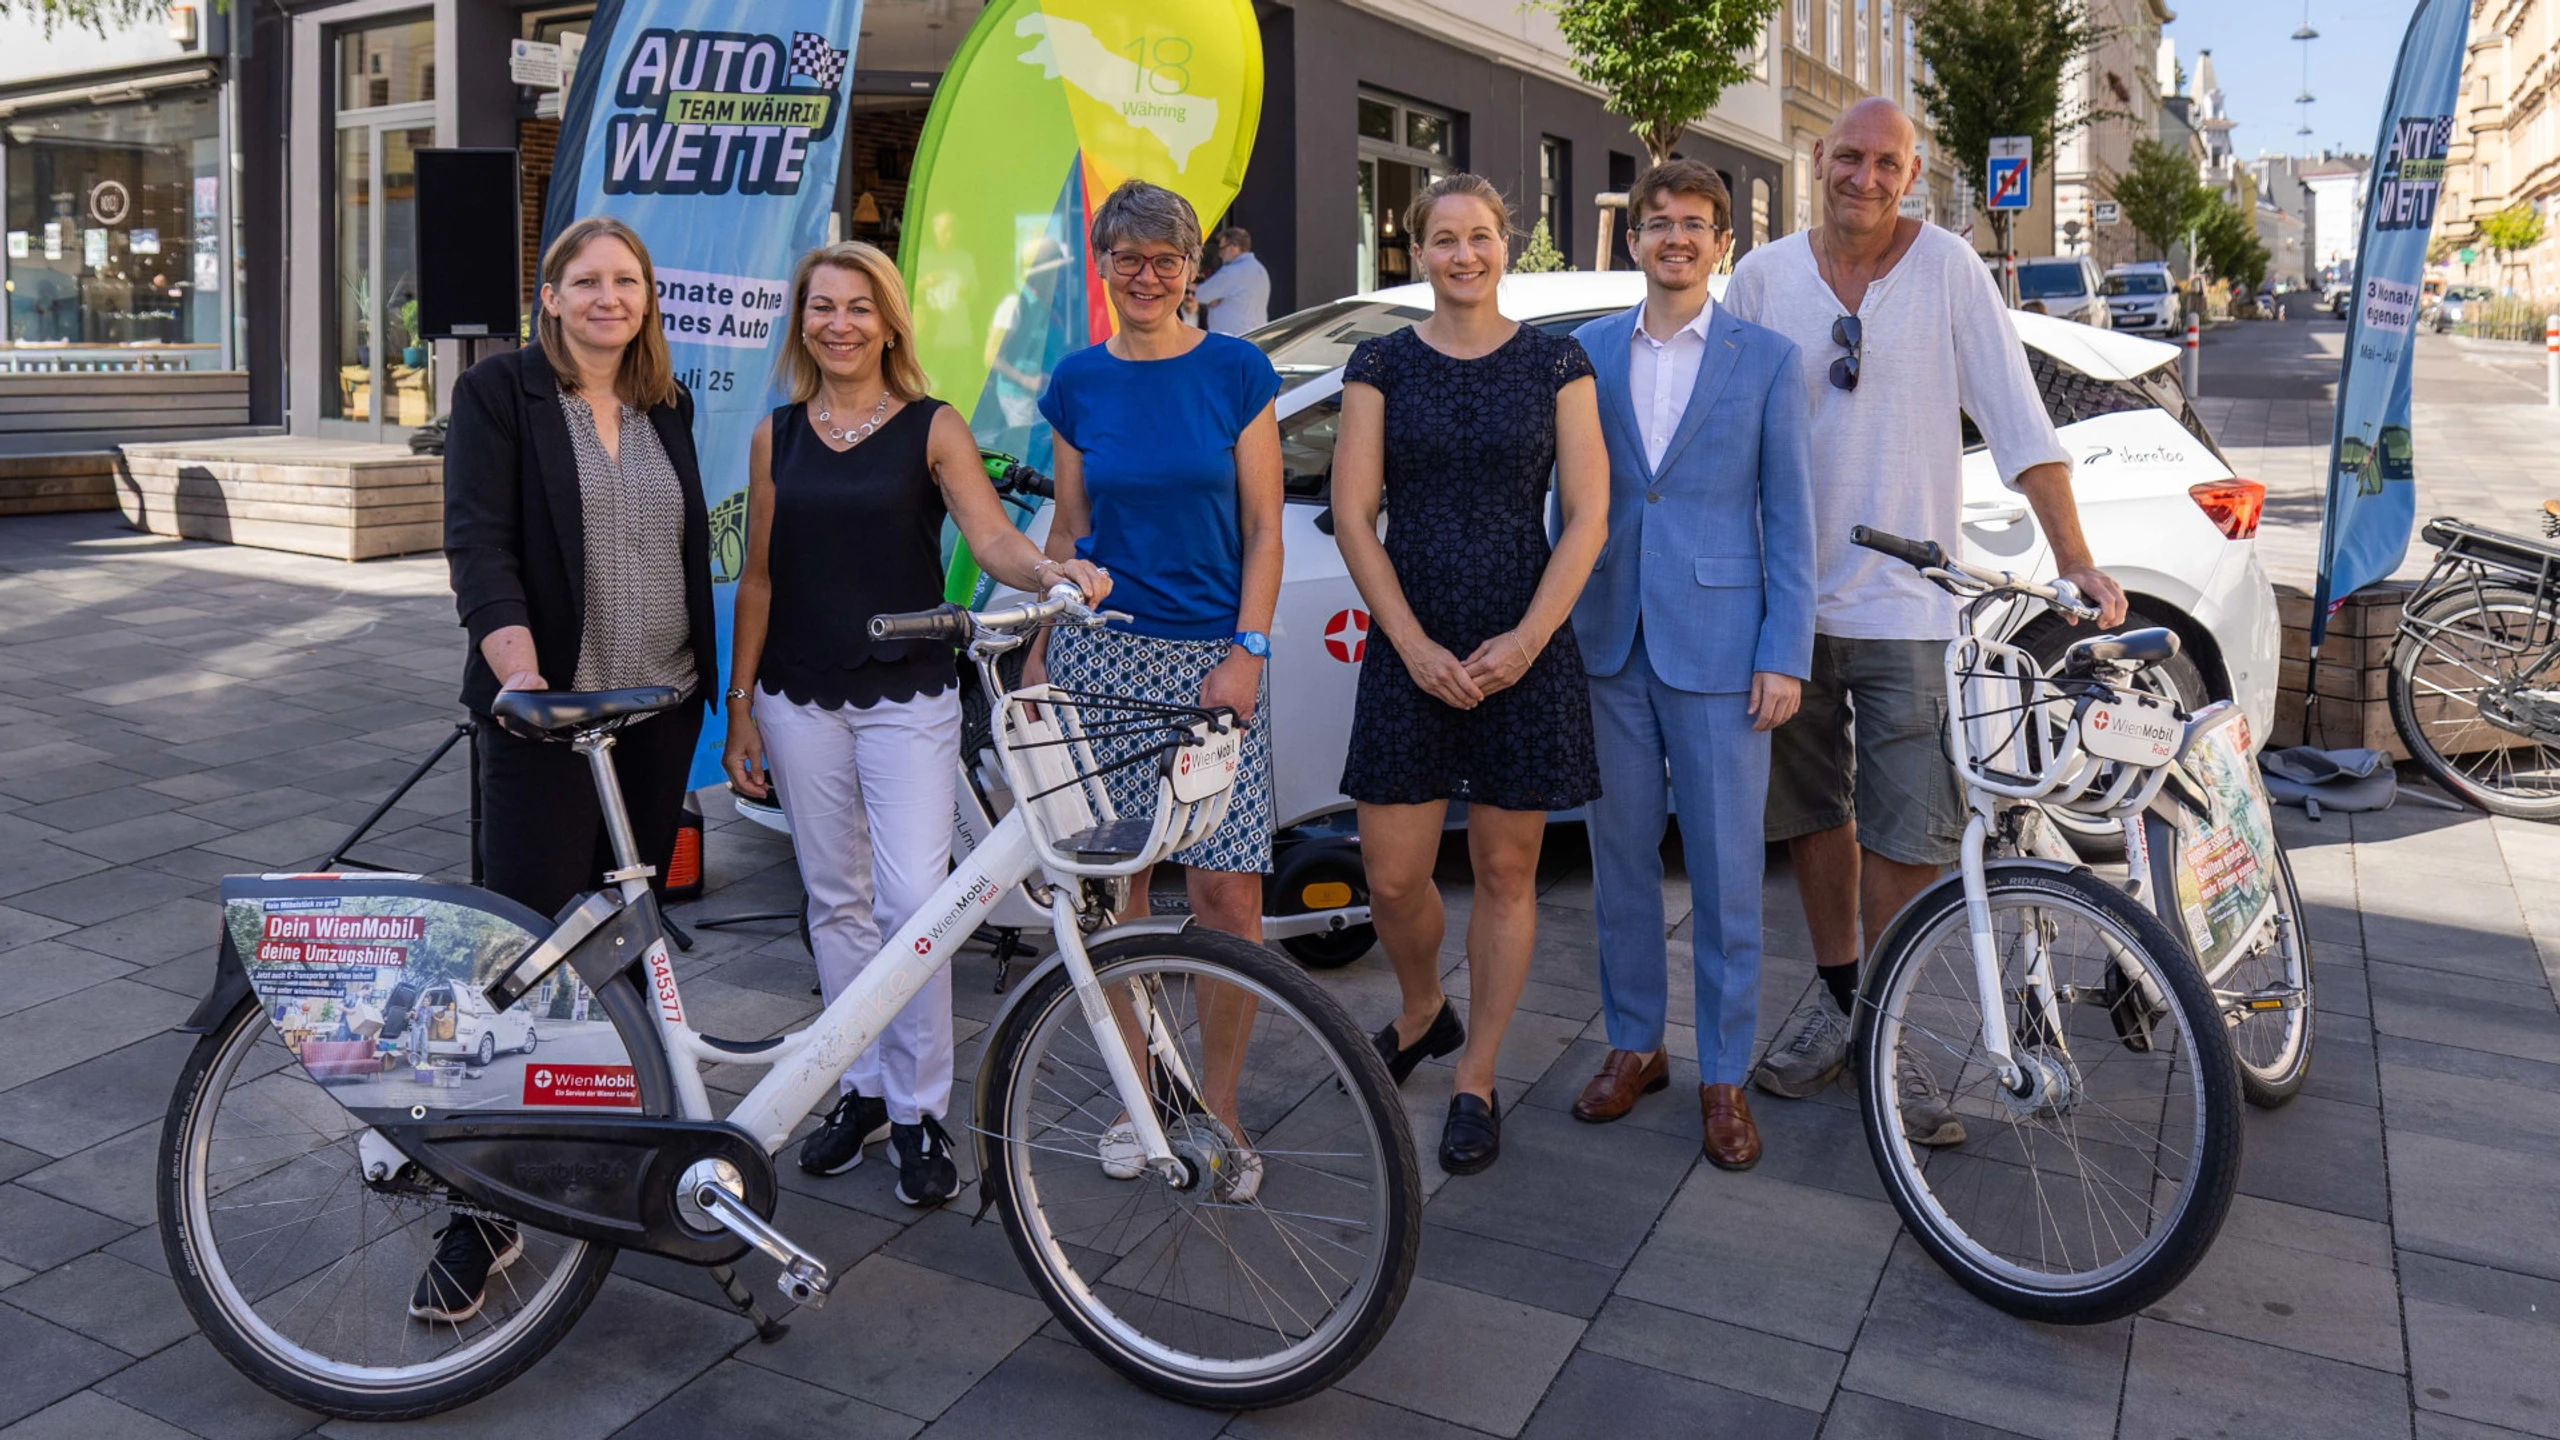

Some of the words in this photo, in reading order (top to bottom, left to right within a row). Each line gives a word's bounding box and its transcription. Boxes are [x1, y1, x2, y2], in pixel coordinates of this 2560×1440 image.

[625, 36, 777, 94] AUTO
[1124, 36, 1193, 96] 18
[680, 98, 735, 121] TEAM
[1122, 101, 1188, 123] Währing
[612, 122, 811, 183] WETTE
[656, 279, 734, 306] onate
[2367, 282, 2376, 298] 3
[708, 370, 735, 392] 25
[2111, 717, 2174, 742] WienMobil
[1192, 738, 1235, 768] WienMobil
[2152, 743, 2171, 756] Rad
[2009, 877, 2038, 887] RIDE
[2196, 858, 2225, 883] Sollten
[979, 884, 999, 905] Rad
[928, 875, 990, 939] WienMobil
[270, 917, 309, 938] Dein
[316, 918, 419, 940] WienMobil,
[261, 943, 301, 960] deine
[305, 944, 402, 967] Umzugshilfe.
[256, 972, 272, 980] Jetzt
[650, 952, 682, 1023] 345377
[555, 1073, 636, 1088] WienMobil
[565, 1089, 585, 1097] Service
[597, 1090, 615, 1098] Wiener
